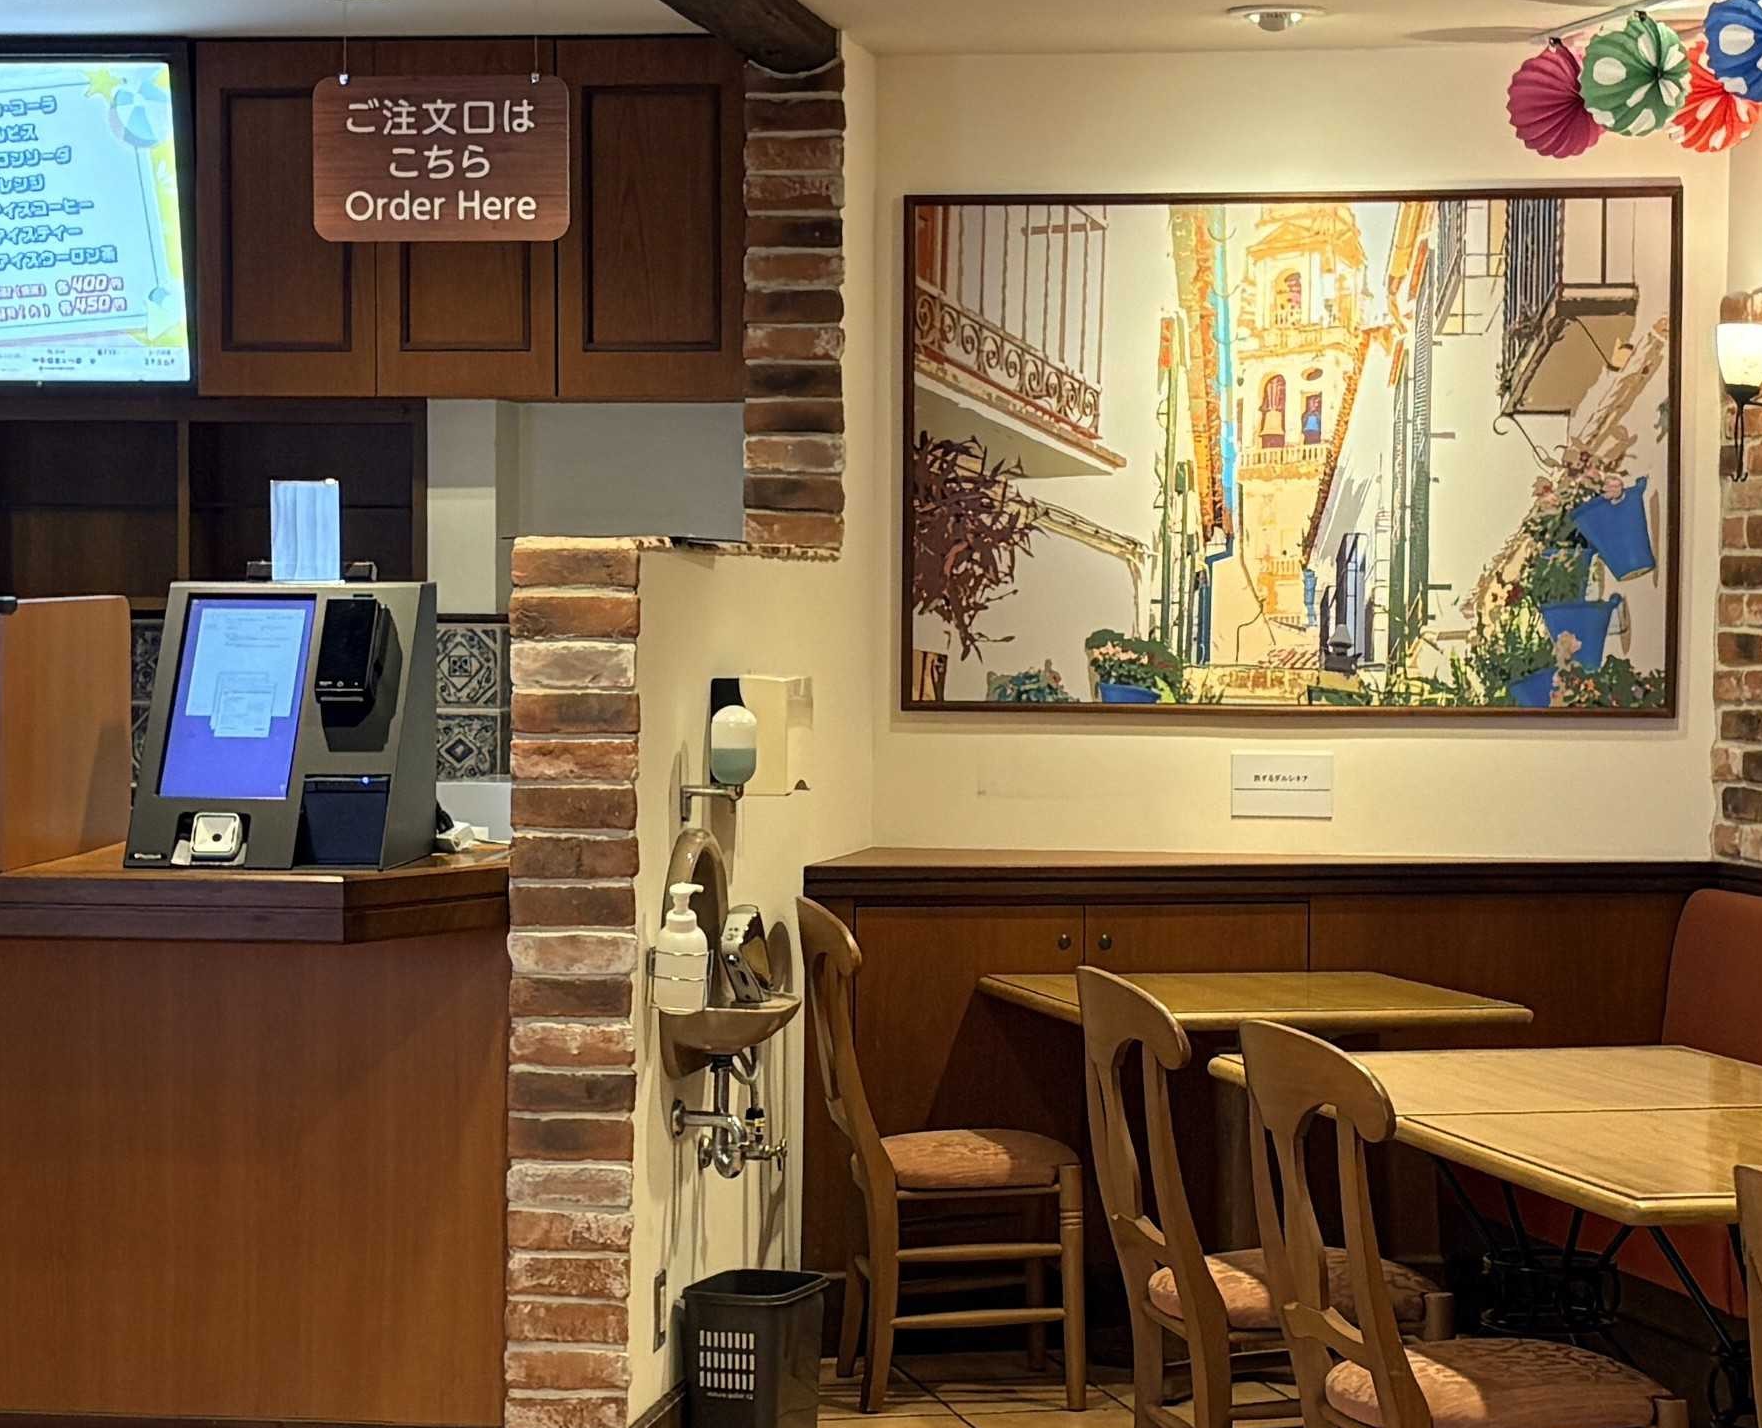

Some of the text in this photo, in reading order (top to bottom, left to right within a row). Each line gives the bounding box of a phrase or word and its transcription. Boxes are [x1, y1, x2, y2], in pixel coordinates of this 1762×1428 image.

[345, 97, 535, 136] ご注文口は
[389, 143, 491, 179] こちら
[344, 189, 537, 221] Order Here
